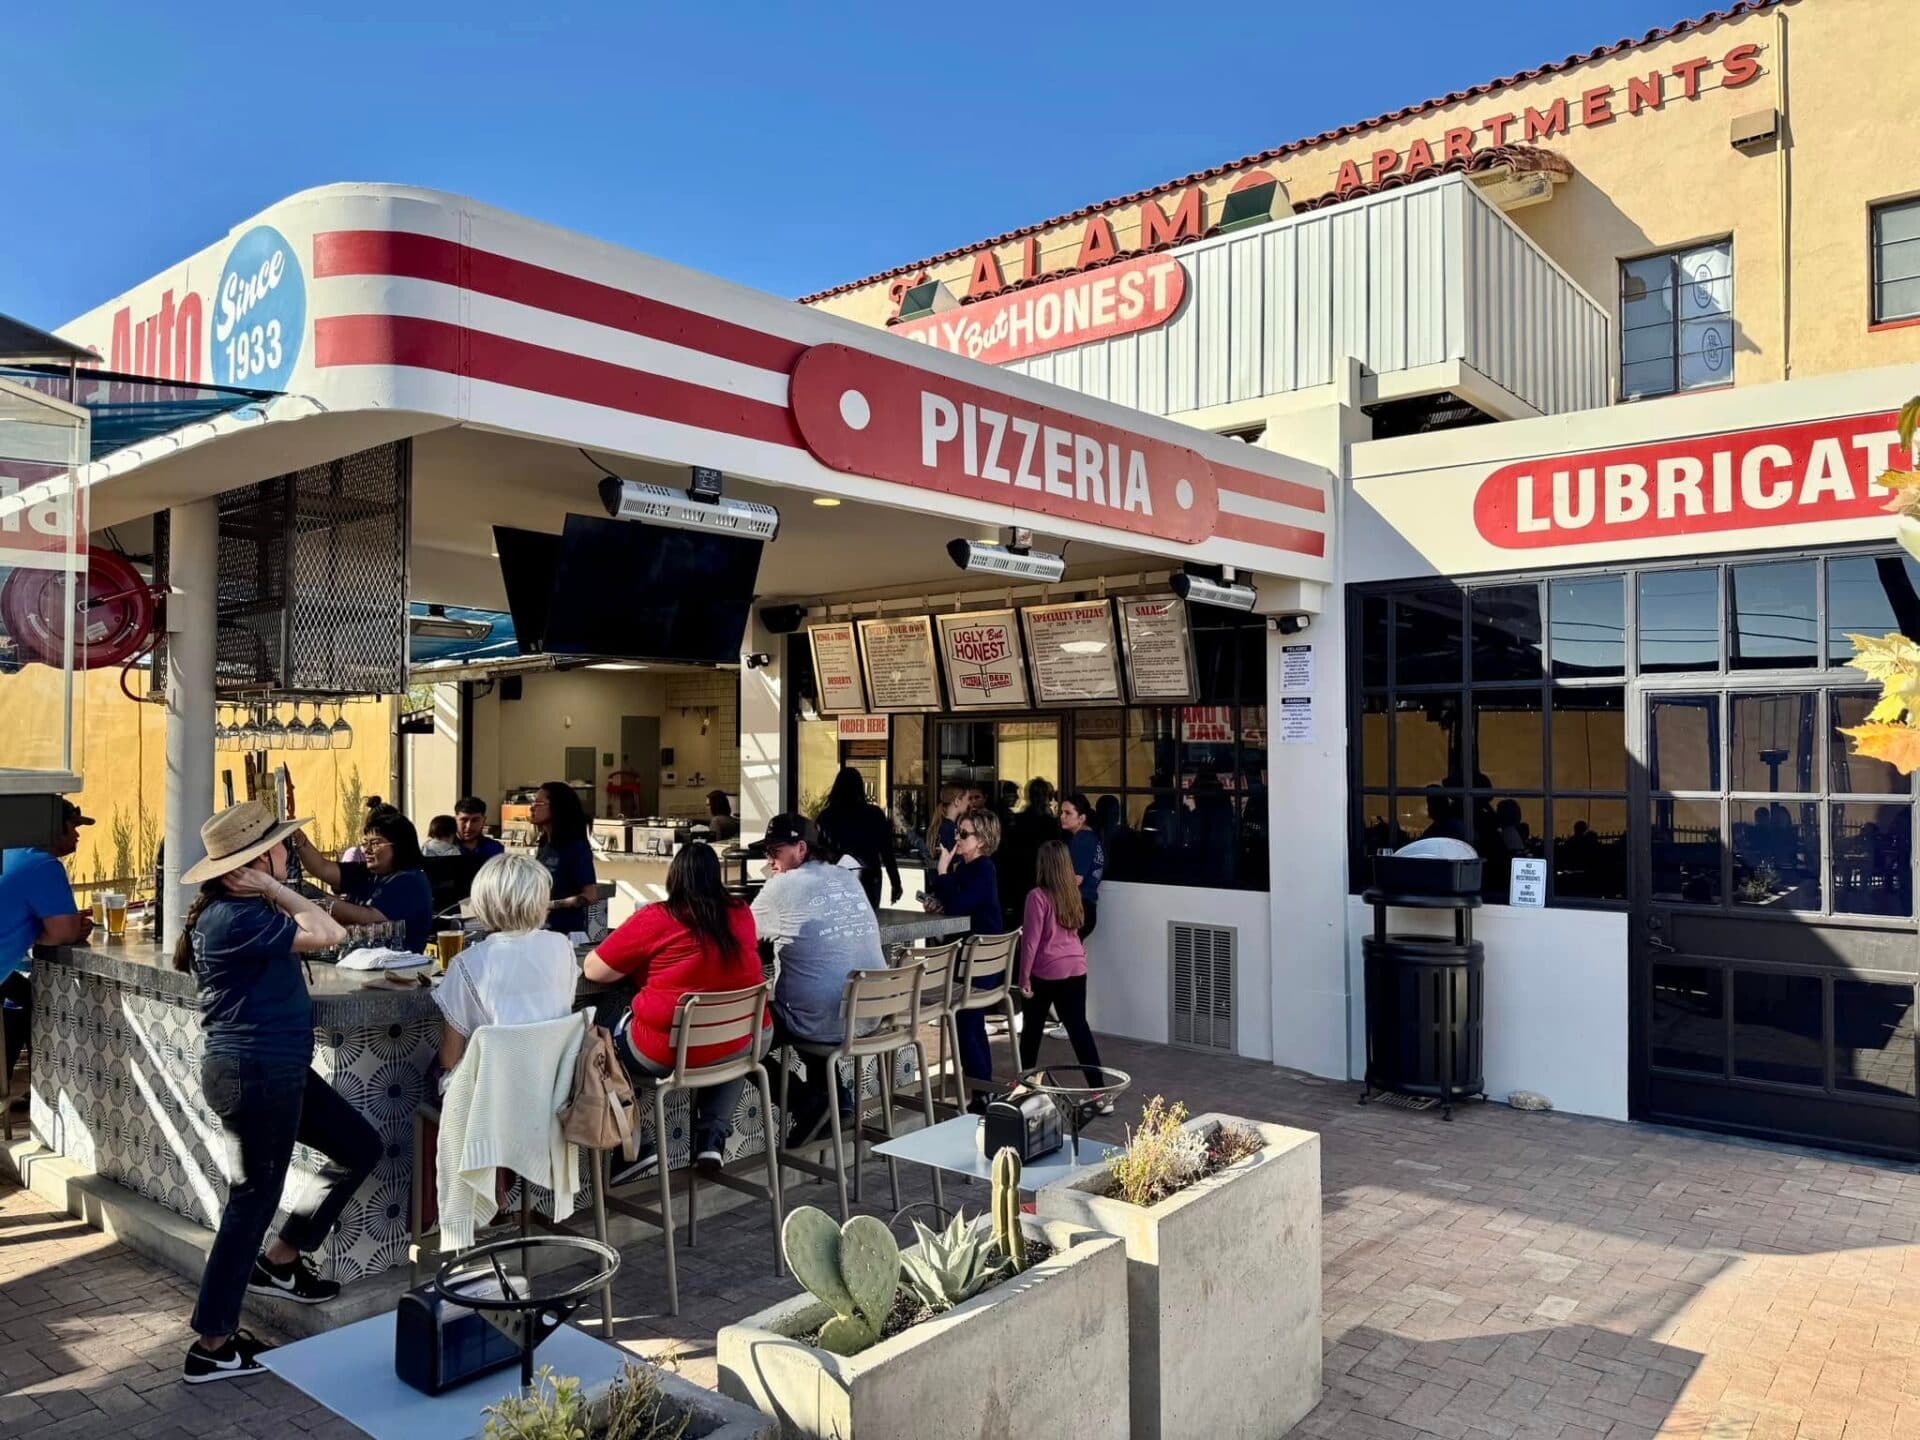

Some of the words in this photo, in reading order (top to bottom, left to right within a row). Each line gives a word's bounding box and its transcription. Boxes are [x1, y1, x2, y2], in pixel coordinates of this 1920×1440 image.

[1334, 44, 1758, 194] APARTMENTS
[216, 250, 286, 342] Since
[964, 307, 1008, 359] But
[1009, 261, 1177, 347] HONEST
[109, 288, 202, 404] Auto
[226, 319, 282, 384] 1933
[920, 390, 1153, 517] PIZZERIA
[953, 630, 984, 644] UGLY
[986, 628, 1004, 640] But
[955, 641, 1005, 661] HONEST
[1032, 611, 1073, 623] SPECIALTY
[1075, 607, 1105, 619] PIZZAS
[840, 718, 865, 733] ORDER
[866, 717, 886, 732] HERE
